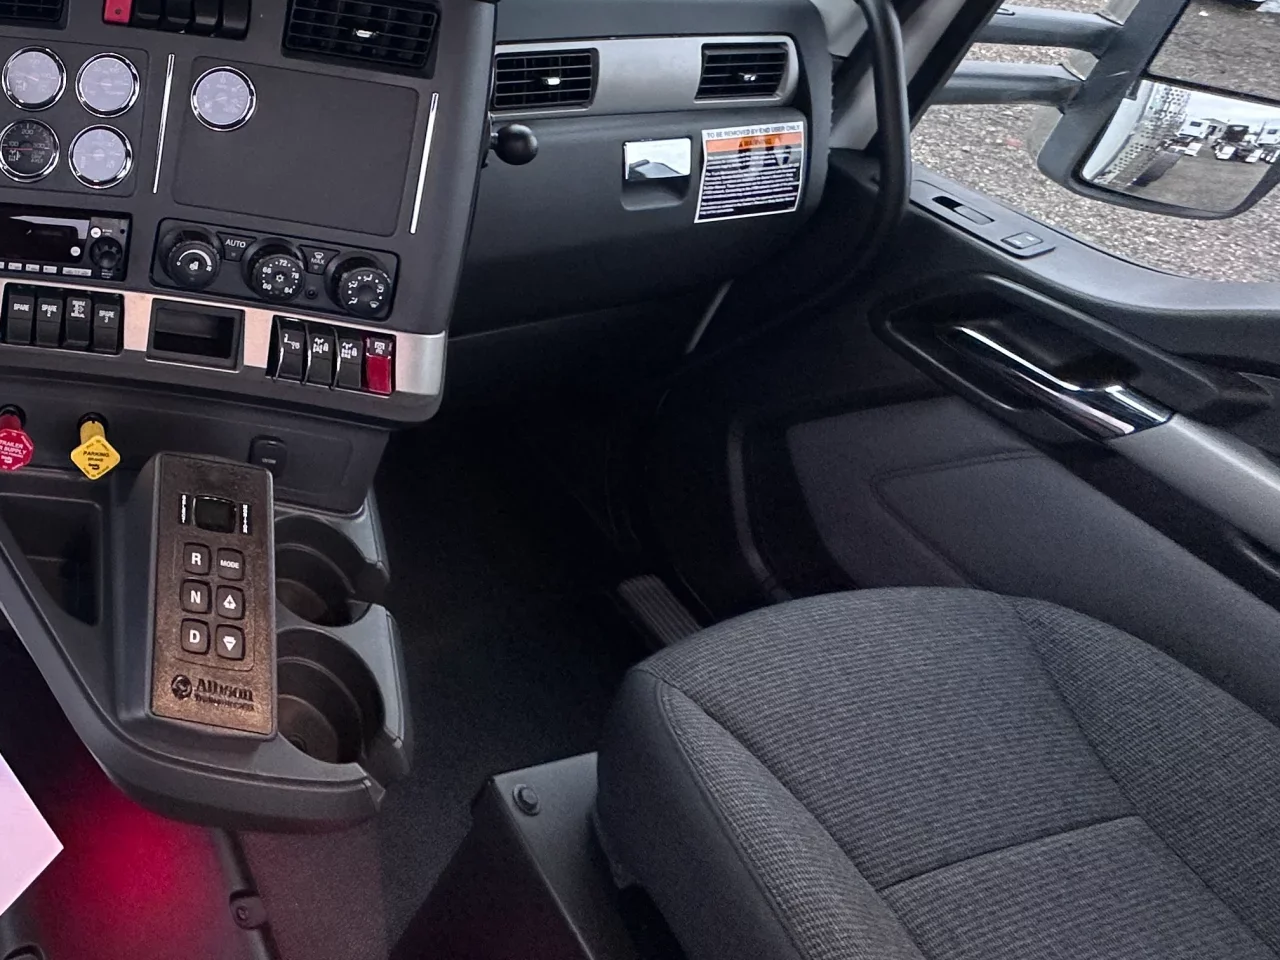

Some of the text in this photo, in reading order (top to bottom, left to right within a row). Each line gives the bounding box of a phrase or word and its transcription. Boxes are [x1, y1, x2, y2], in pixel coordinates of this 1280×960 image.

[724, 129, 750, 137] REMOVED
[225, 239, 246, 248] AUTO
[14, 303, 30, 312] SPARE
[42, 304, 58, 312] SPARE
[99, 310, 115, 318] SPARE
[0, 440, 24, 449] TRAILER
[4, 446, 27, 455] SUPPLY
[192, 552, 201, 566] R
[220, 560, 240, 569] MODE
[190, 590, 200, 604] N
[190, 630, 200, 643] D
